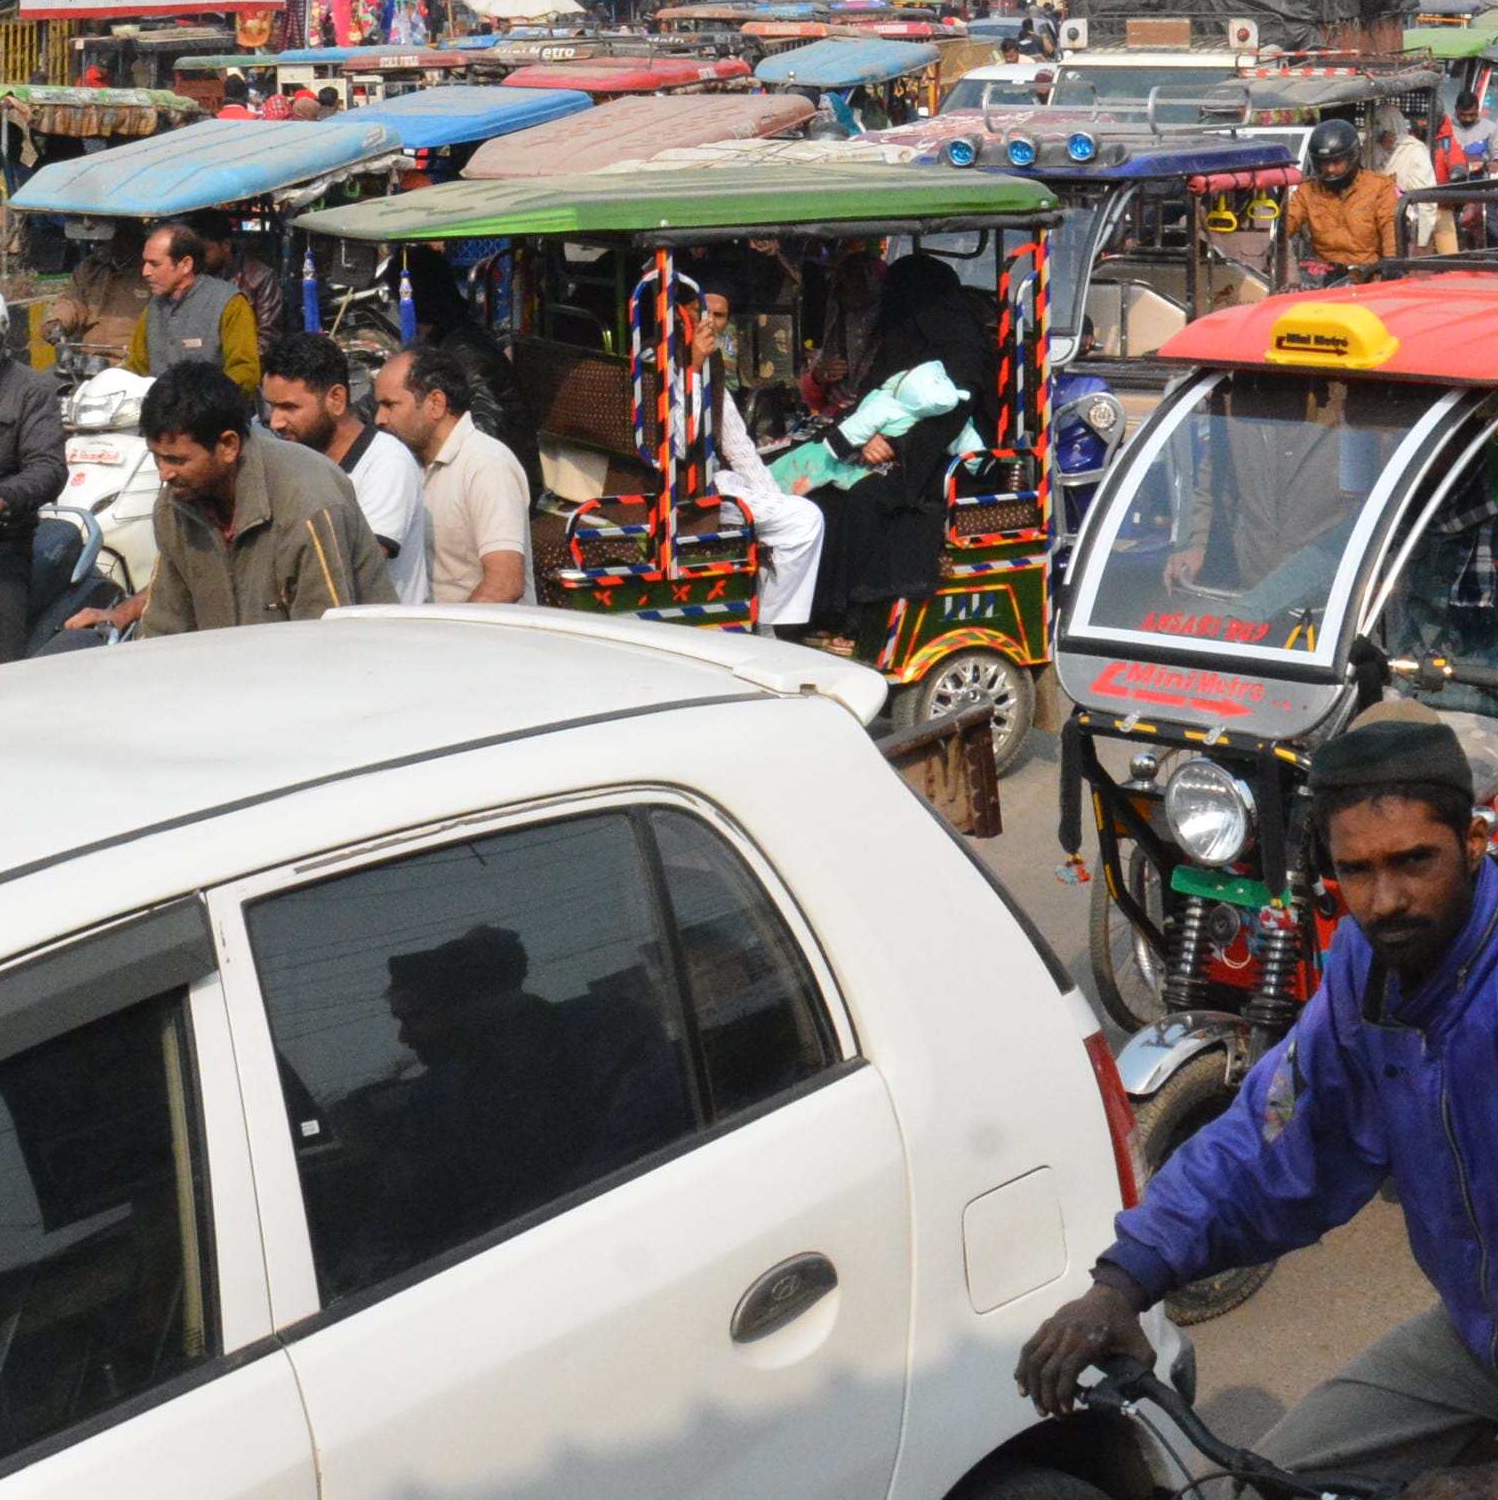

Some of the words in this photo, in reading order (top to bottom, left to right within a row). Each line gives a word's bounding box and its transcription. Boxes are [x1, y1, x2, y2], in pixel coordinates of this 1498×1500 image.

[1286, 332, 1311, 345] Mini
[1314, 334, 1349, 348] Metro
[1138, 611, 1222, 638] ANSARI
[1125, 660, 1198, 692] Mini
[1196, 668, 1265, 701] Metro
